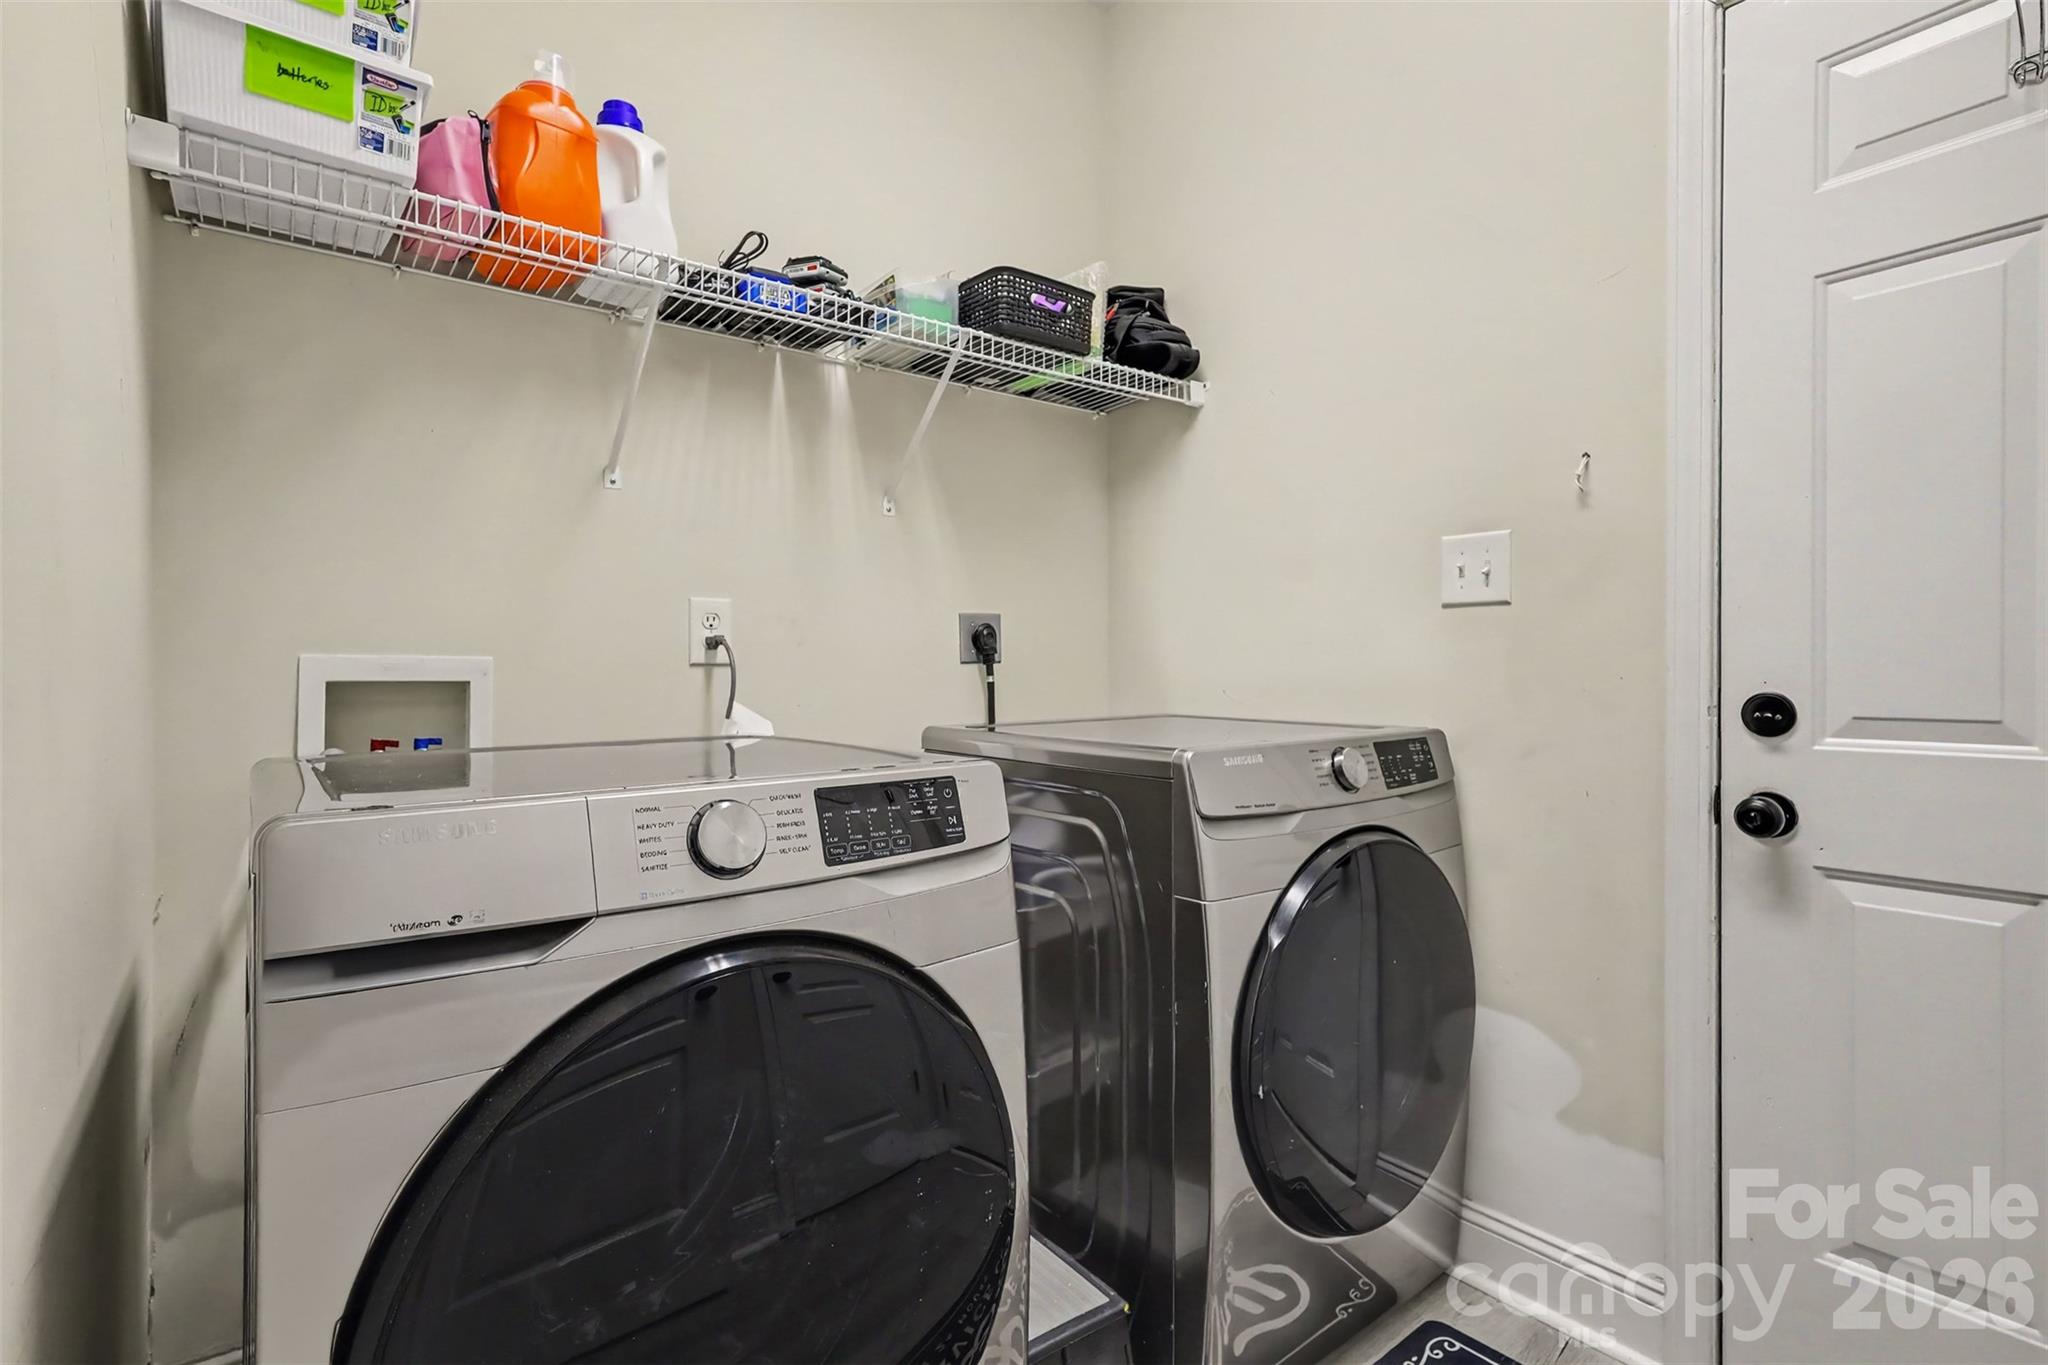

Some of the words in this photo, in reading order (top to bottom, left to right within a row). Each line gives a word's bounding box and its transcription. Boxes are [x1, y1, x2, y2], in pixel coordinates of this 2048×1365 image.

[276, 62, 330, 90] batteries
[1223, 753, 1264, 767] SAMSUNG
[635, 805, 662, 814] NORMAL
[637, 822, 657, 831] HEAVY
[658, 821, 675, 829] DUTY
[639, 836, 662, 845] WHITES
[640, 849, 668, 859] BEDDING
[641, 863, 668, 873] SANITIZE
